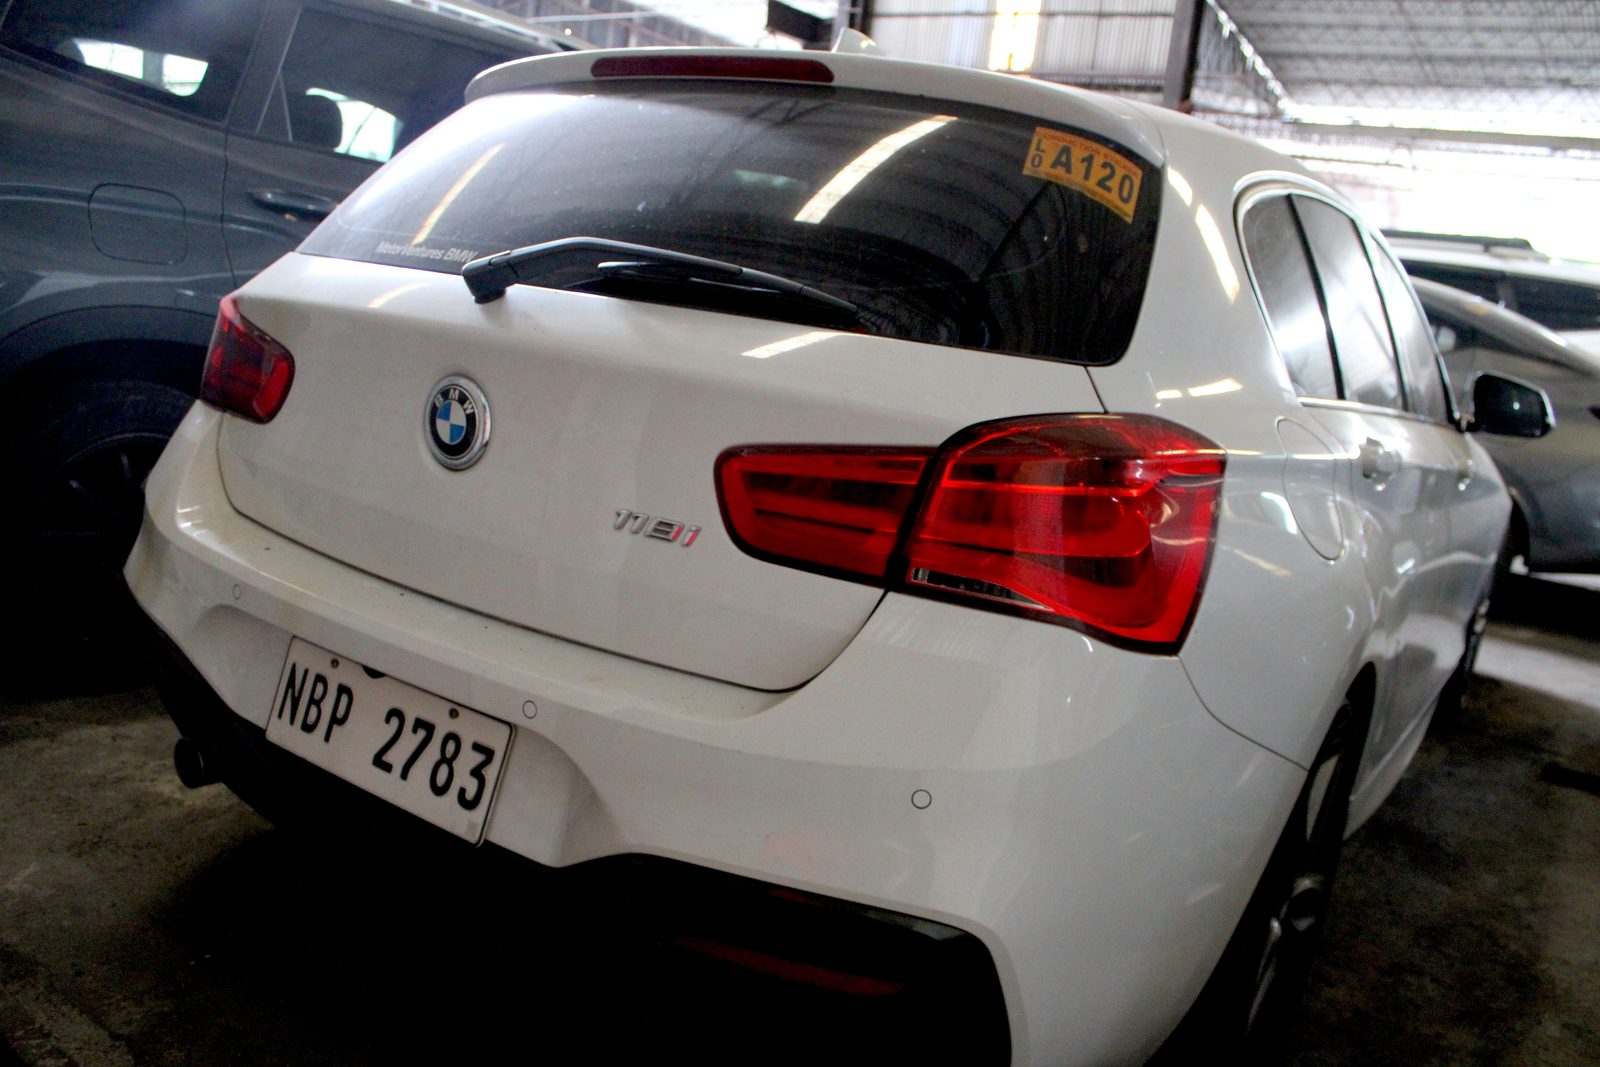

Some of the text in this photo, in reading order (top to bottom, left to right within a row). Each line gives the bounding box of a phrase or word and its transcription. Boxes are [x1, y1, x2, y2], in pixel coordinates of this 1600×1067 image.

[1051, 145, 1134, 204] A120
[443, 247, 479, 262] BMW
[434, 388, 474, 415] BMW
[613, 508, 702, 547] 118i
[278, 662, 495, 811] NBP 2783
